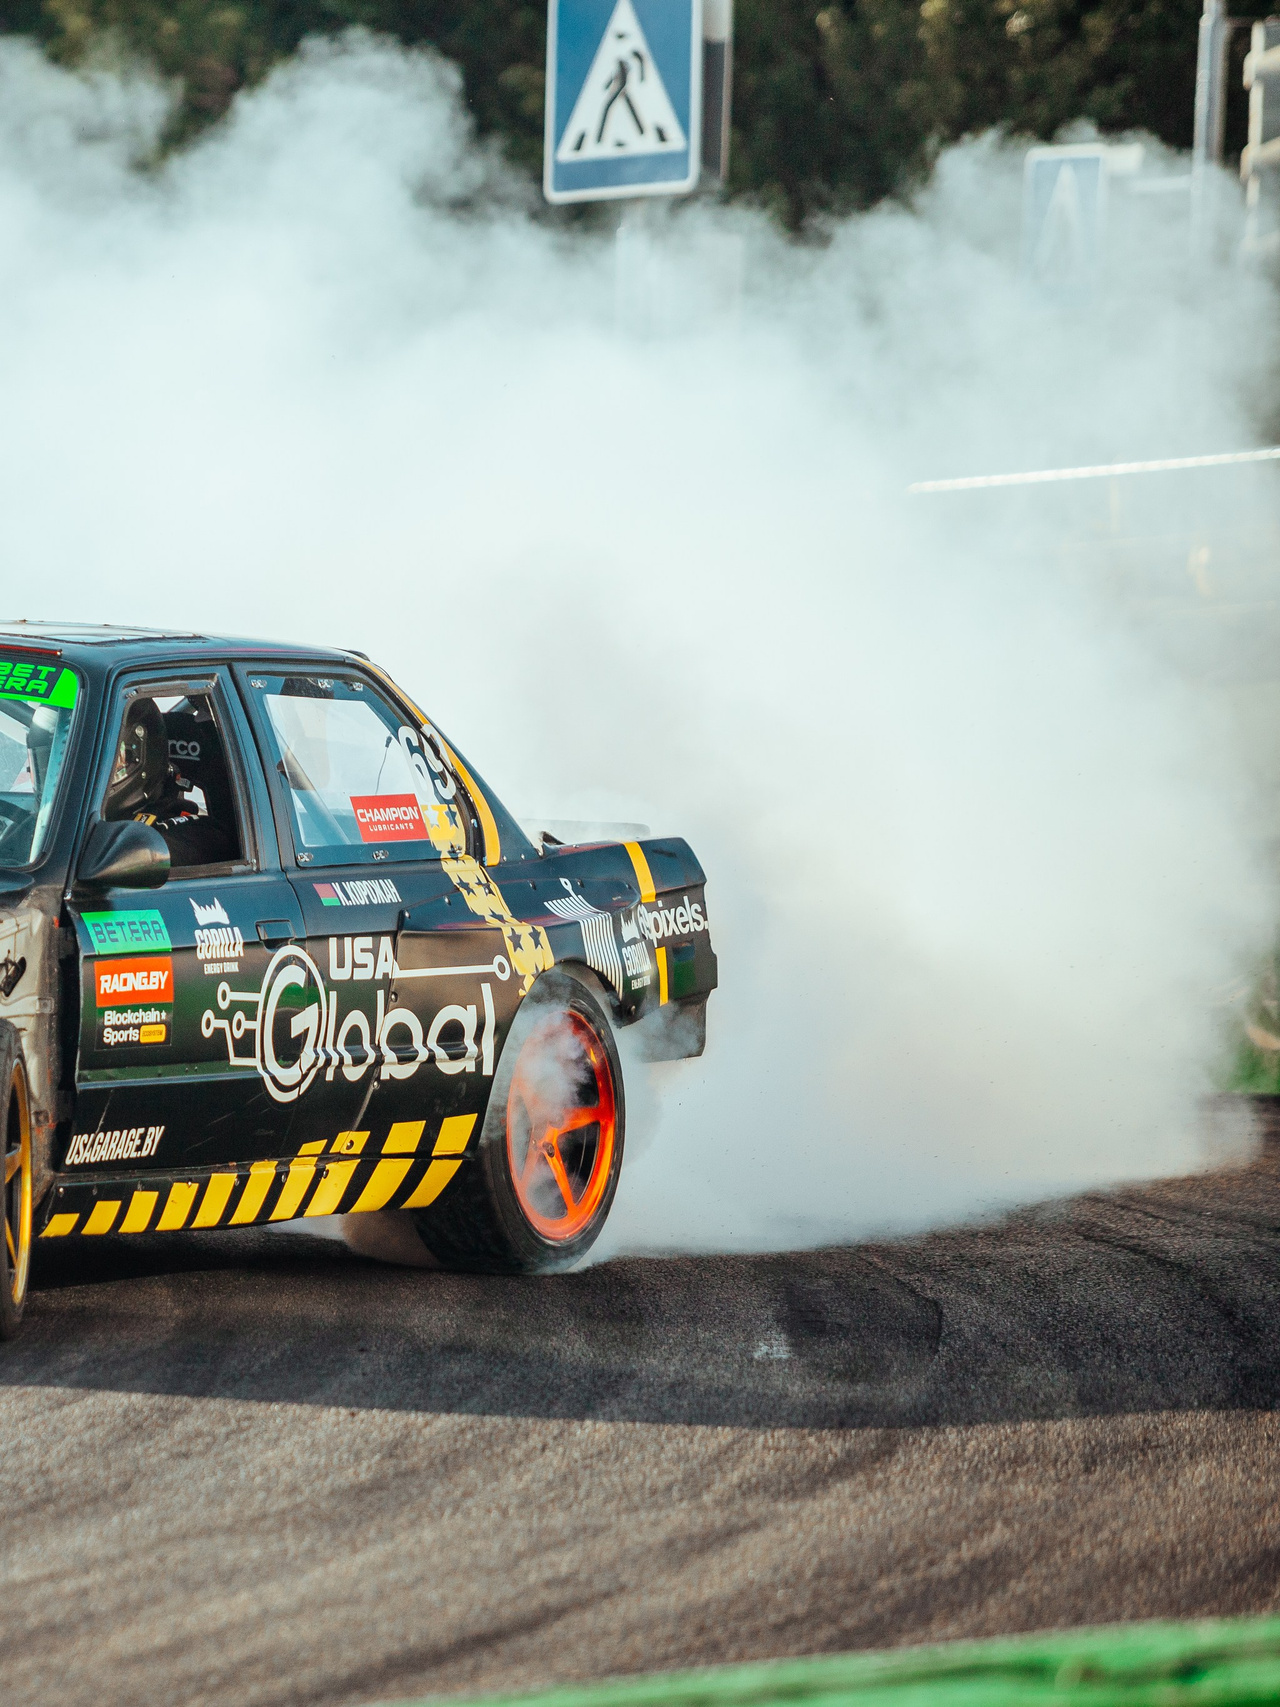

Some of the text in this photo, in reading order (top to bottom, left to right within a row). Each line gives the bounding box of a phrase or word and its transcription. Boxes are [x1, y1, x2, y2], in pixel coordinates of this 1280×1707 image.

[398, 723, 456, 804] 69
[356, 806, 419, 822] CHAMPION
[369, 823, 414, 832] LUBRICANTS
[194, 927, 244, 960] GORILLA
[328, 936, 396, 980] USA
[104, 1008, 160, 1026] Blockchain
[103, 1027, 139, 1046] Sports
[65, 1125, 165, 1165] USAGARAGE.BY
